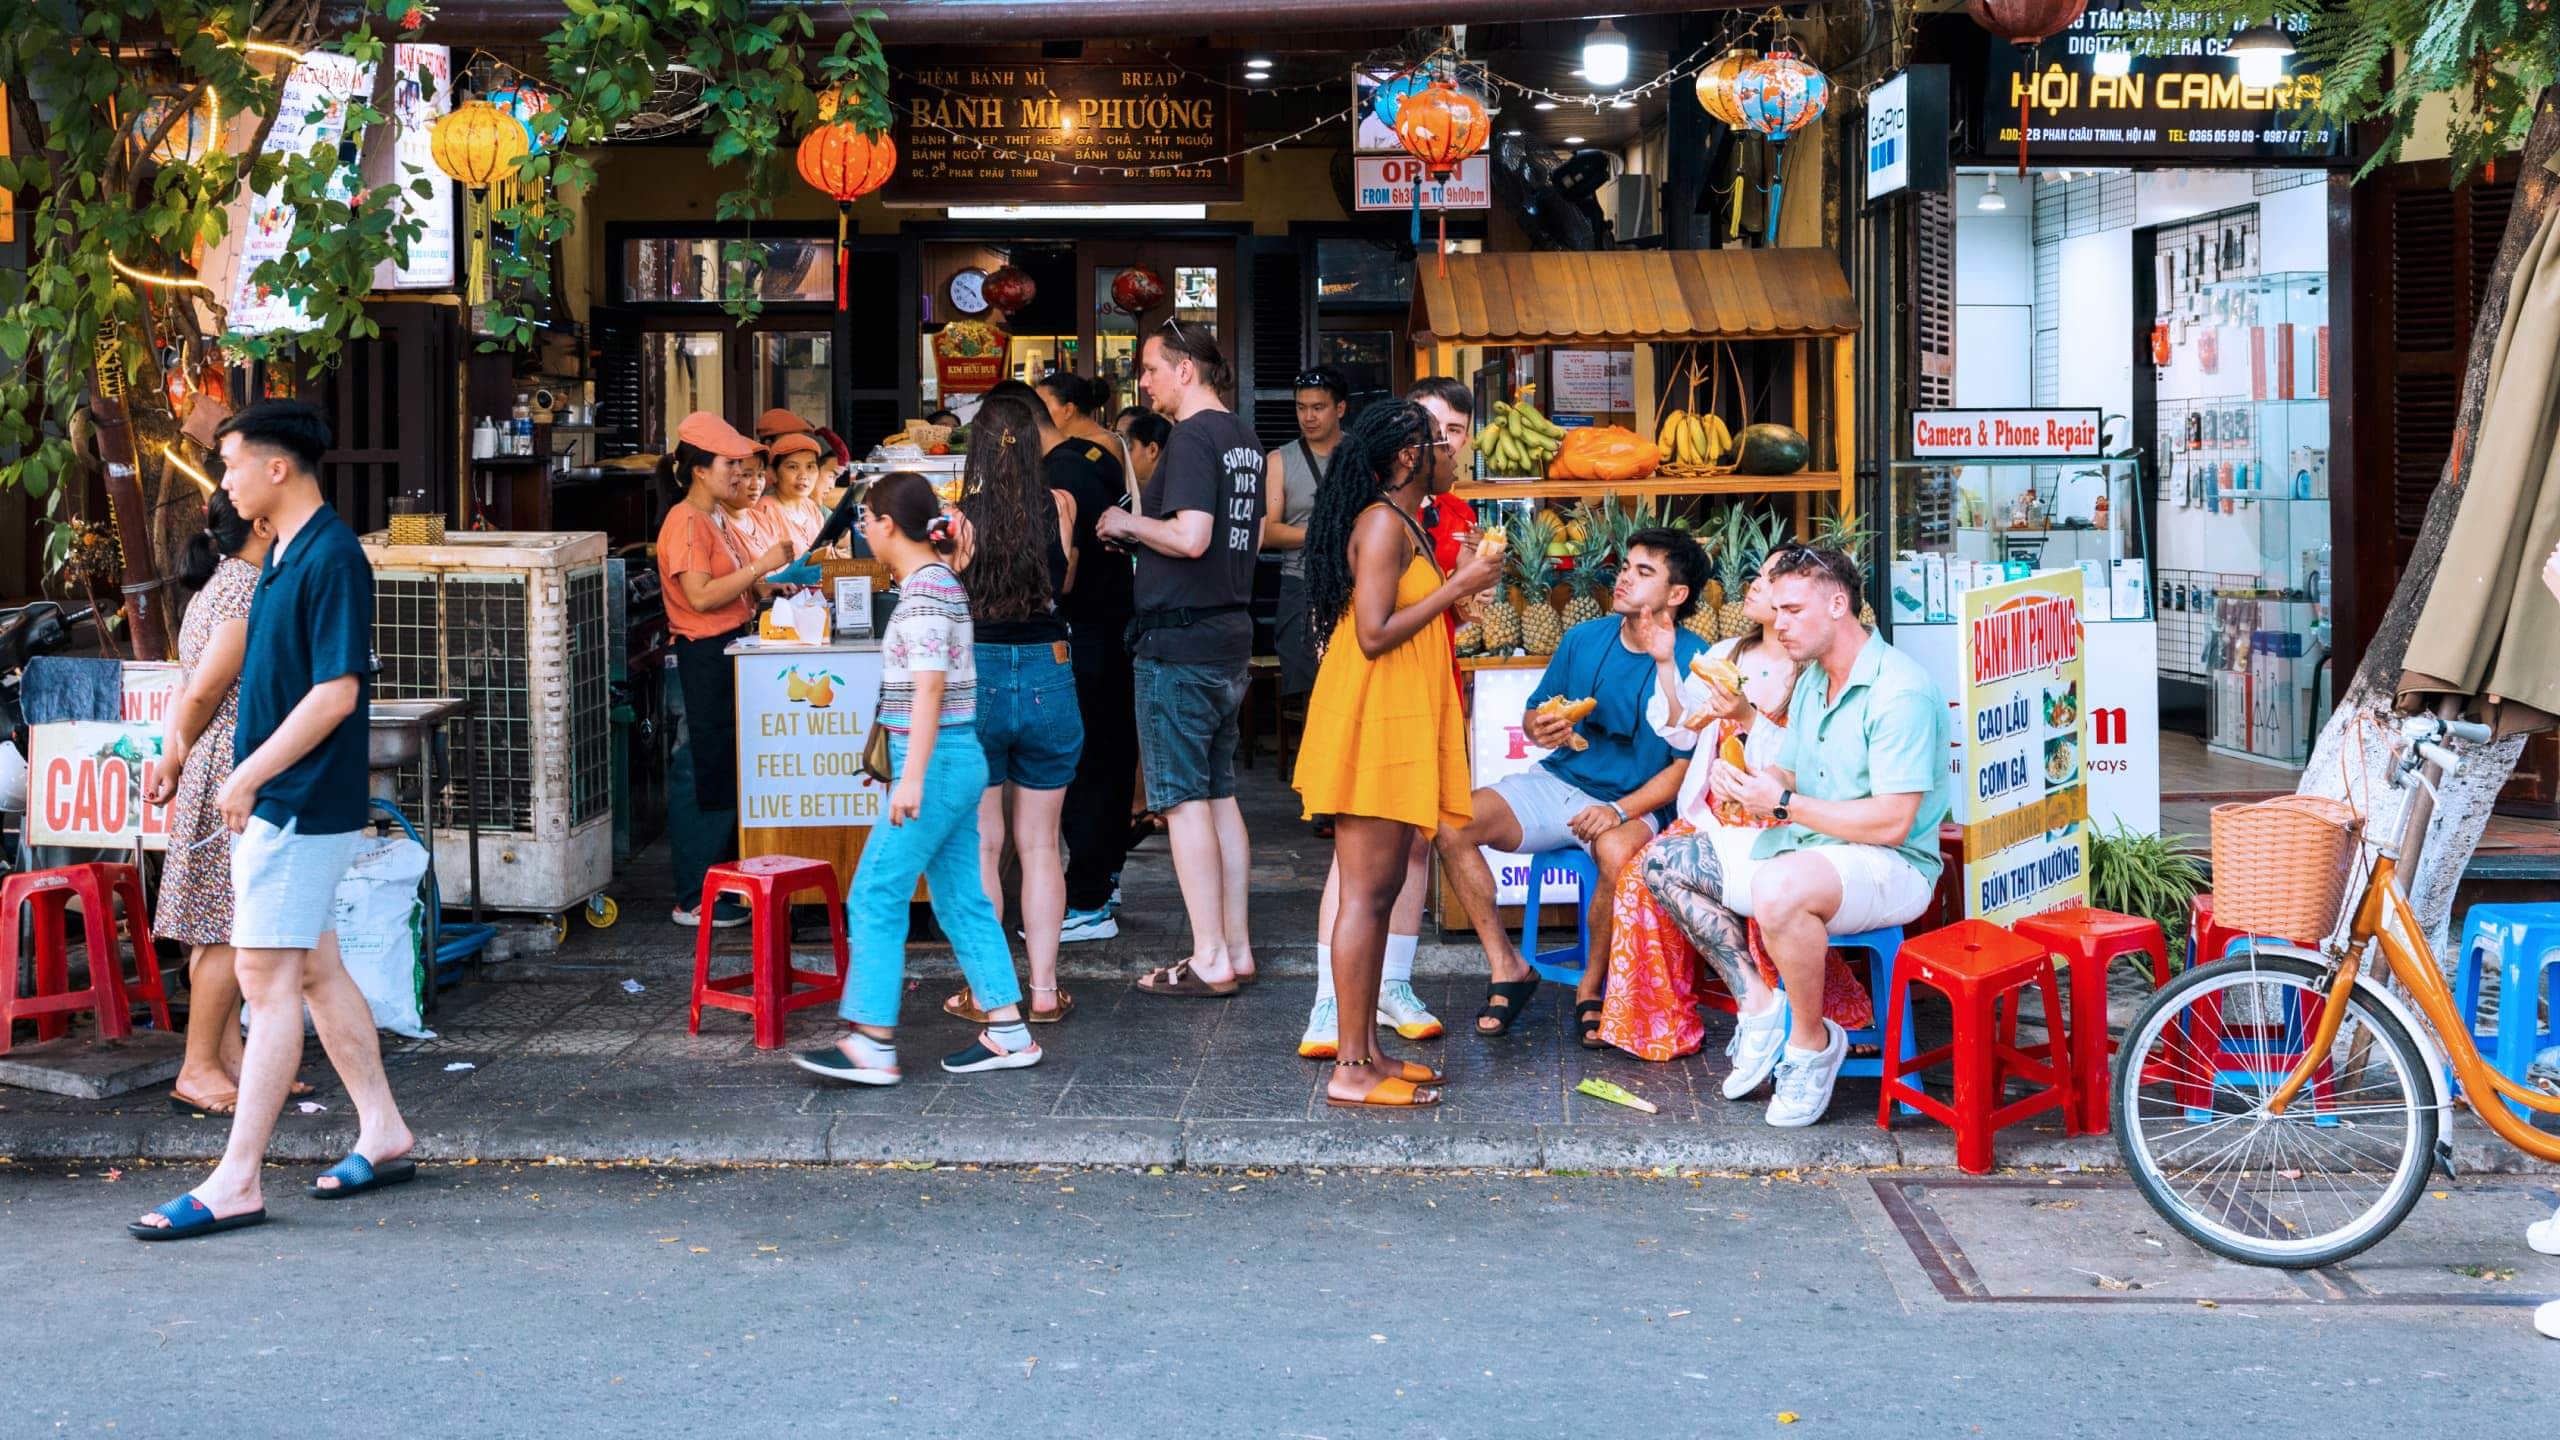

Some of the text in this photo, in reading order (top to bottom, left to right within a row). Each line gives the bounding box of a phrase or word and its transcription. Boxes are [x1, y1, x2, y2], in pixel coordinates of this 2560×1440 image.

[2088, 8, 2124, 29] TÂM
[1121, 72, 1178, 86] BREAD
[2011, 63, 2079, 116] HỘI
[2090, 72, 2143, 109] AN
[1020, 88, 1062, 129] MÌ
[1078, 94, 1215, 134] PHƯỢNG
[1871, 108, 1904, 141] GoPro
[2000, 126, 2157, 144] ADD: 2B PHAN CHÂU TRINH, HỘI AN
[2168, 129, 2187, 142] TEL:
[2214, 129, 2226, 142] 05
[2228, 129, 2240, 142] 99
[1150, 150, 1183, 160] XANH
[1362, 187, 1390, 204] FROM
[1447, 186, 1485, 205] 9h00pm
[1917, 417, 2095, 452] Camera & Phone Repair
[1975, 595, 2076, 682] BÁNH MÌ PHƯỢNG
[761, 711, 863, 736] EAT WELL
[1978, 707, 2002, 741] CAO
[2006, 690, 2028, 733] LẦU
[757, 753, 807, 778] FEEL
[1979, 760, 2007, 798] CƠM
[2011, 749, 2028, 787] GÀ
[46, 757, 128, 834] CAO
[748, 793, 879, 819] LIVE BETTER
[1982, 845, 2079, 911] BÚN THỊT NƯỚNG
